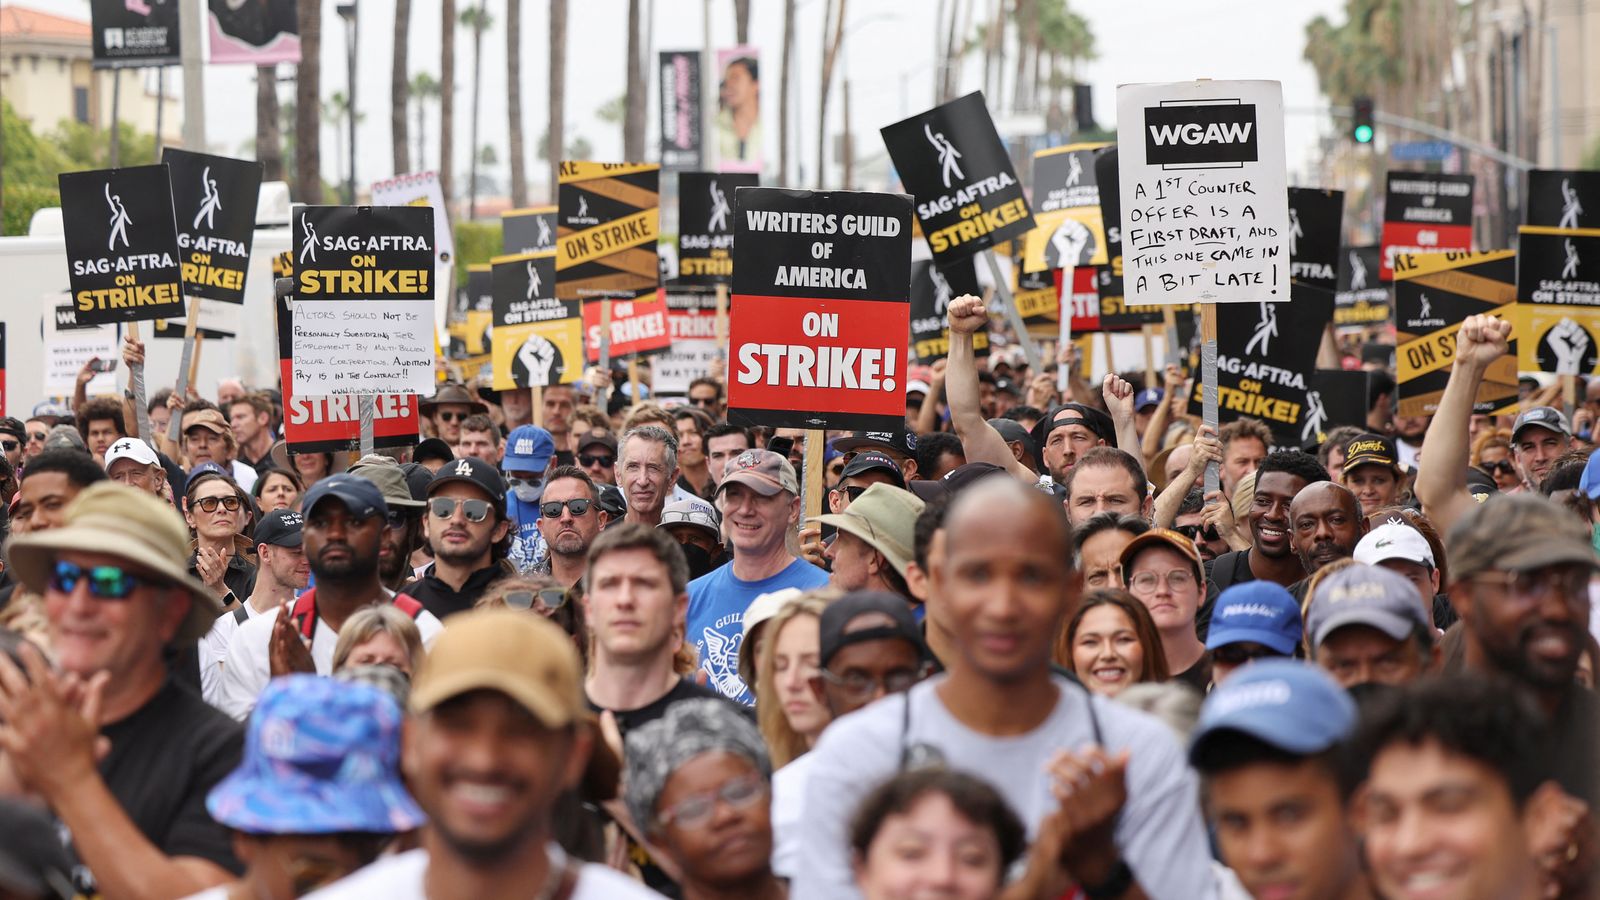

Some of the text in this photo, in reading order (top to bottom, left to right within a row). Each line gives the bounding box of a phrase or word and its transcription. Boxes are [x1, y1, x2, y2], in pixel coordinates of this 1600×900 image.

[1149, 122, 1252, 146] WGAW
[1135, 177, 1256, 200] A 1ST COUNTER
[959, 202, 982, 219] ON
[1131, 204, 1256, 223] OFFER IS A
[746, 210, 901, 238] WRITERS GUILD
[929, 198, 1029, 253] STRIKE!
[565, 217, 651, 260] ON STRIKE
[1130, 229, 1184, 246] FIRST
[1189, 227, 1241, 242] DRAFT,
[1249, 226, 1278, 238] AND
[1416, 229, 1438, 246] ON
[191, 252, 211, 265] ON
[811, 241, 834, 260] OF
[1132, 252, 1168, 269] THIS
[1174, 250, 1204, 262] ONE
[1210, 245, 1254, 262] CAME
[1262, 245, 1279, 258] IN
[351, 255, 376, 267] ON
[115, 274, 136, 287] ON
[300, 269, 428, 294] STRIKE!
[774, 265, 867, 290] AMERICA
[1136, 264, 1278, 295] A BIT LATE!
[77, 283, 180, 311] STRIKE!
[1532, 290, 1554, 303] ON
[294, 303, 336, 320] ACTORS
[342, 311, 377, 320] SHOULD
[383, 311, 401, 320] NOT
[504, 307, 568, 324] ON STRIKE!
[614, 301, 634, 318] ON
[294, 325, 340, 338] PERSONALLY
[589, 311, 666, 349] SRIKE!
[802, 311, 839, 338] ON
[294, 341, 350, 351] EMPLOYMENT
[356, 343, 368, 352] BY
[1407, 342, 1436, 370] ON
[294, 356, 325, 365] DOLLAR
[392, 356, 431, 367] AUDITION
[737, 342, 896, 392] STRIKE!
[295, 369, 311, 382] PAY
[319, 371, 327, 379] IS
[335, 371, 343, 379] IN
[1239, 379, 1262, 394] ON
[455, 459, 473, 476] LA
[715, 612, 744, 629] GUIL
